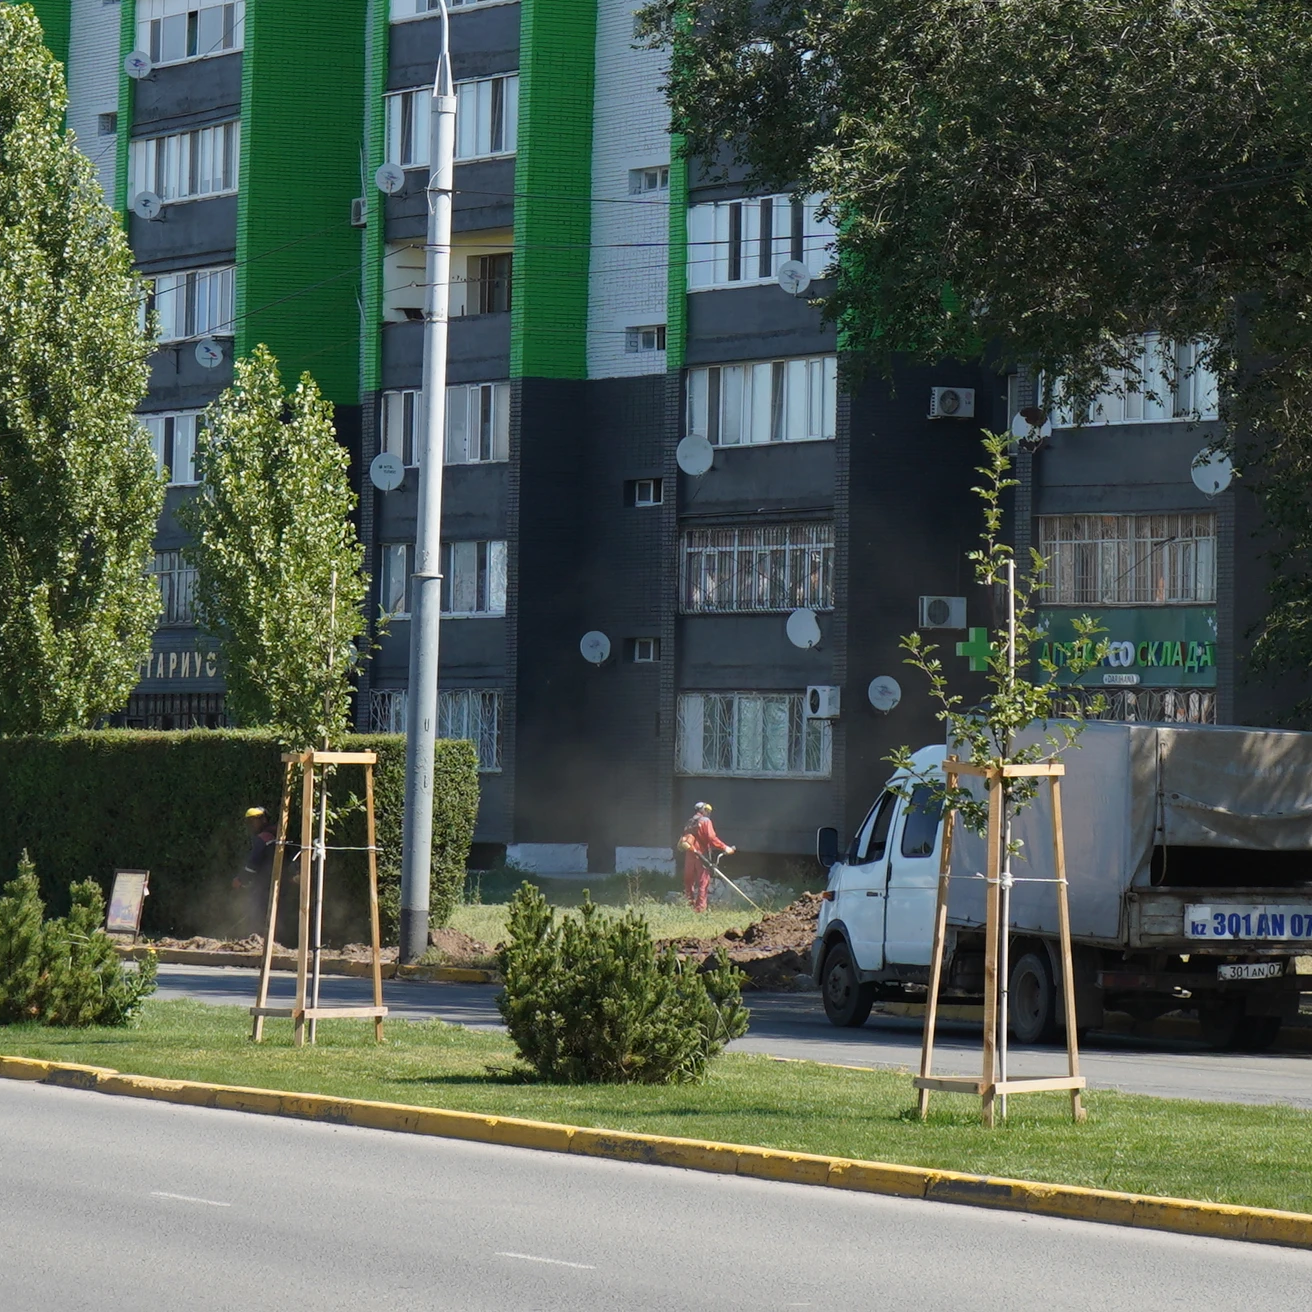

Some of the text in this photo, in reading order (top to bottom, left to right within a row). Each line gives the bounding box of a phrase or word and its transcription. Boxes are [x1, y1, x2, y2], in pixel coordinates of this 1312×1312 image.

[1108, 641, 1135, 667] СО
[1138, 641, 1215, 673] СКЛАДА
[1213, 913, 1252, 936] 301
[1257, 914, 1285, 937] AN
[1229, 966, 1249, 978] 301
[1252, 967, 1265, 977] AN
[1268, 964, 1282, 976] 07
